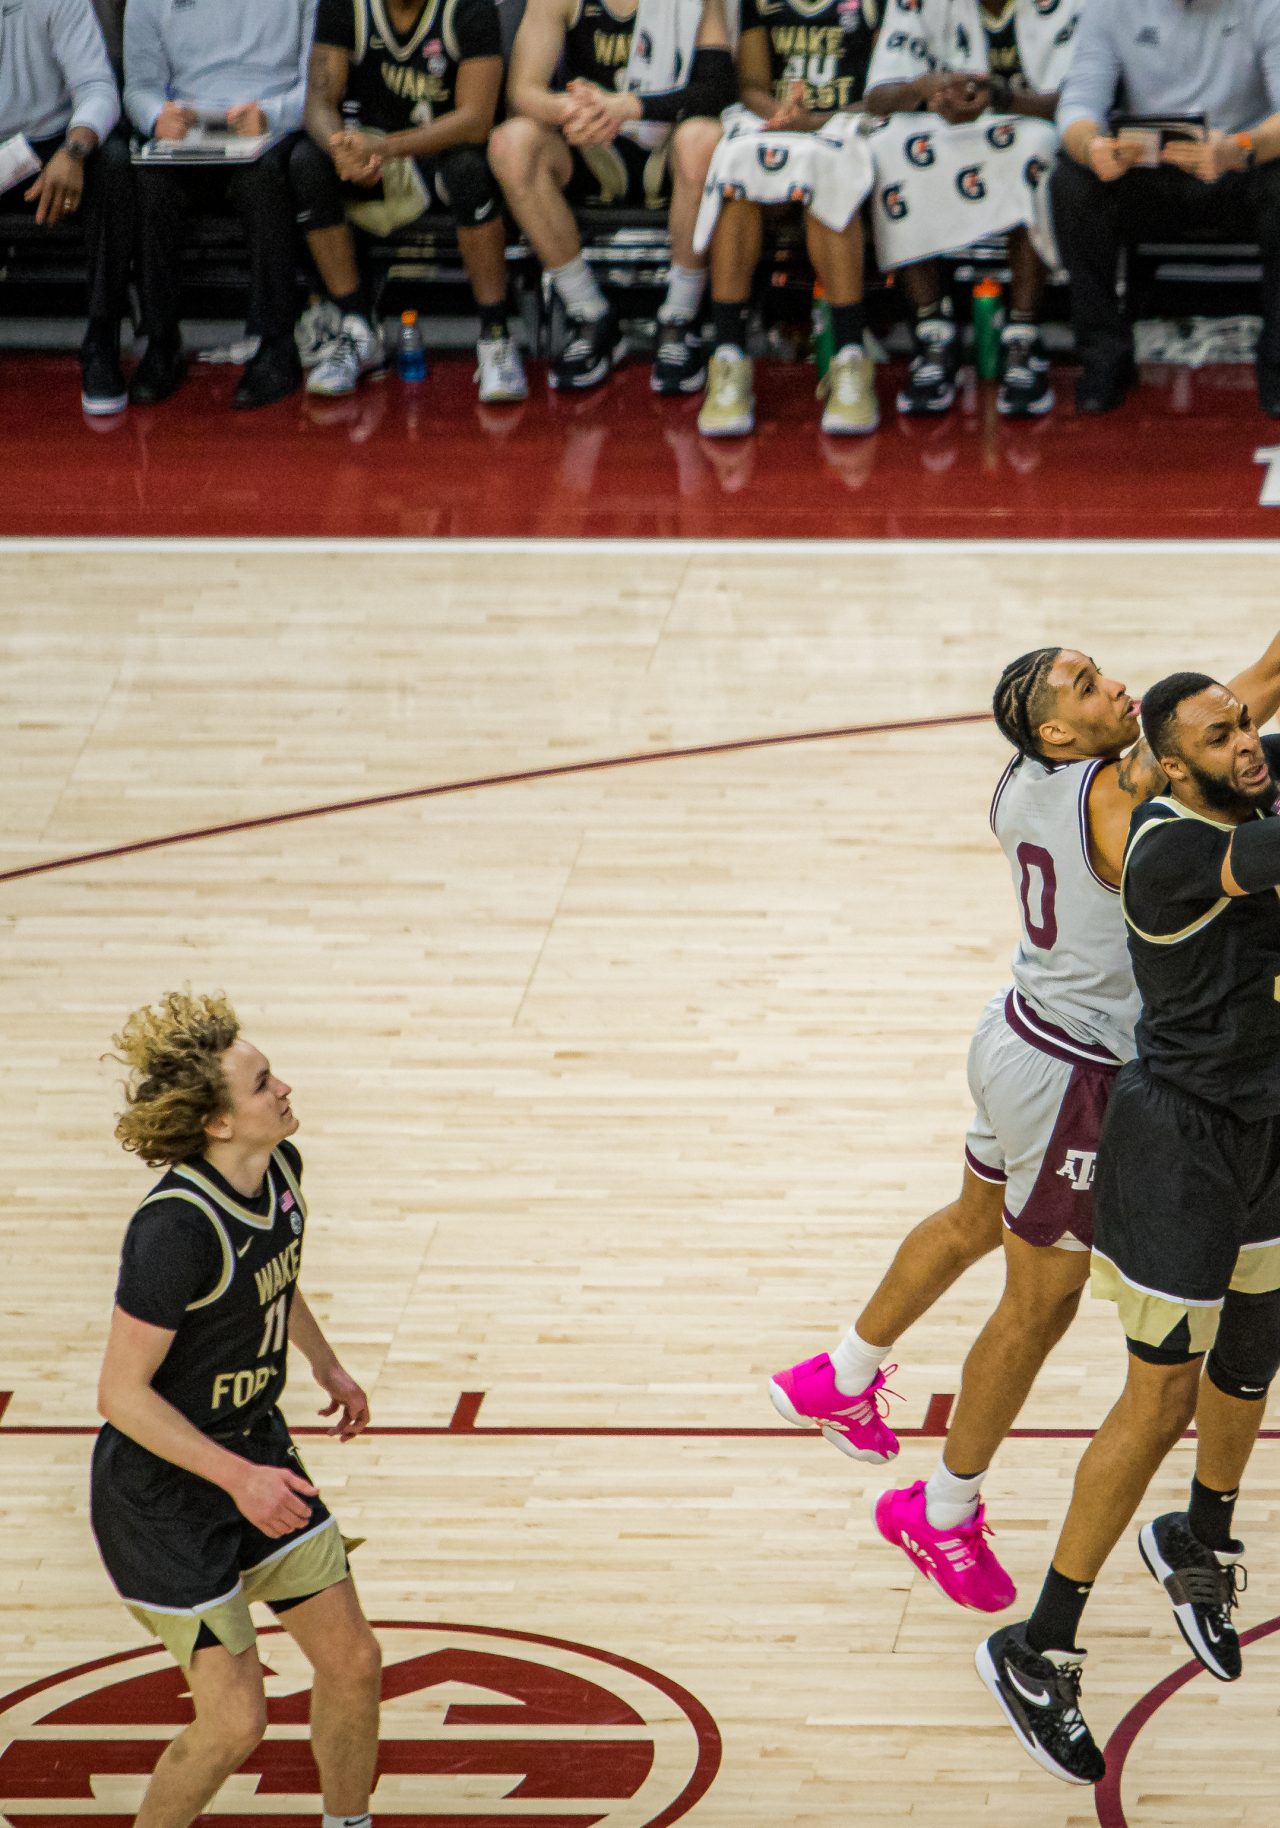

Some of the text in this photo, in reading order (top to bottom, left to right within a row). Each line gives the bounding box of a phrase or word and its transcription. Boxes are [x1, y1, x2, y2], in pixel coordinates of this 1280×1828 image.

[771, 25, 848, 58] WAKE
[1016, 841, 1057, 951] 0
[254, 1238, 299, 1305] WAKE
[257, 1293, 286, 1358] 11
[211, 1366, 277, 1409] FOR
